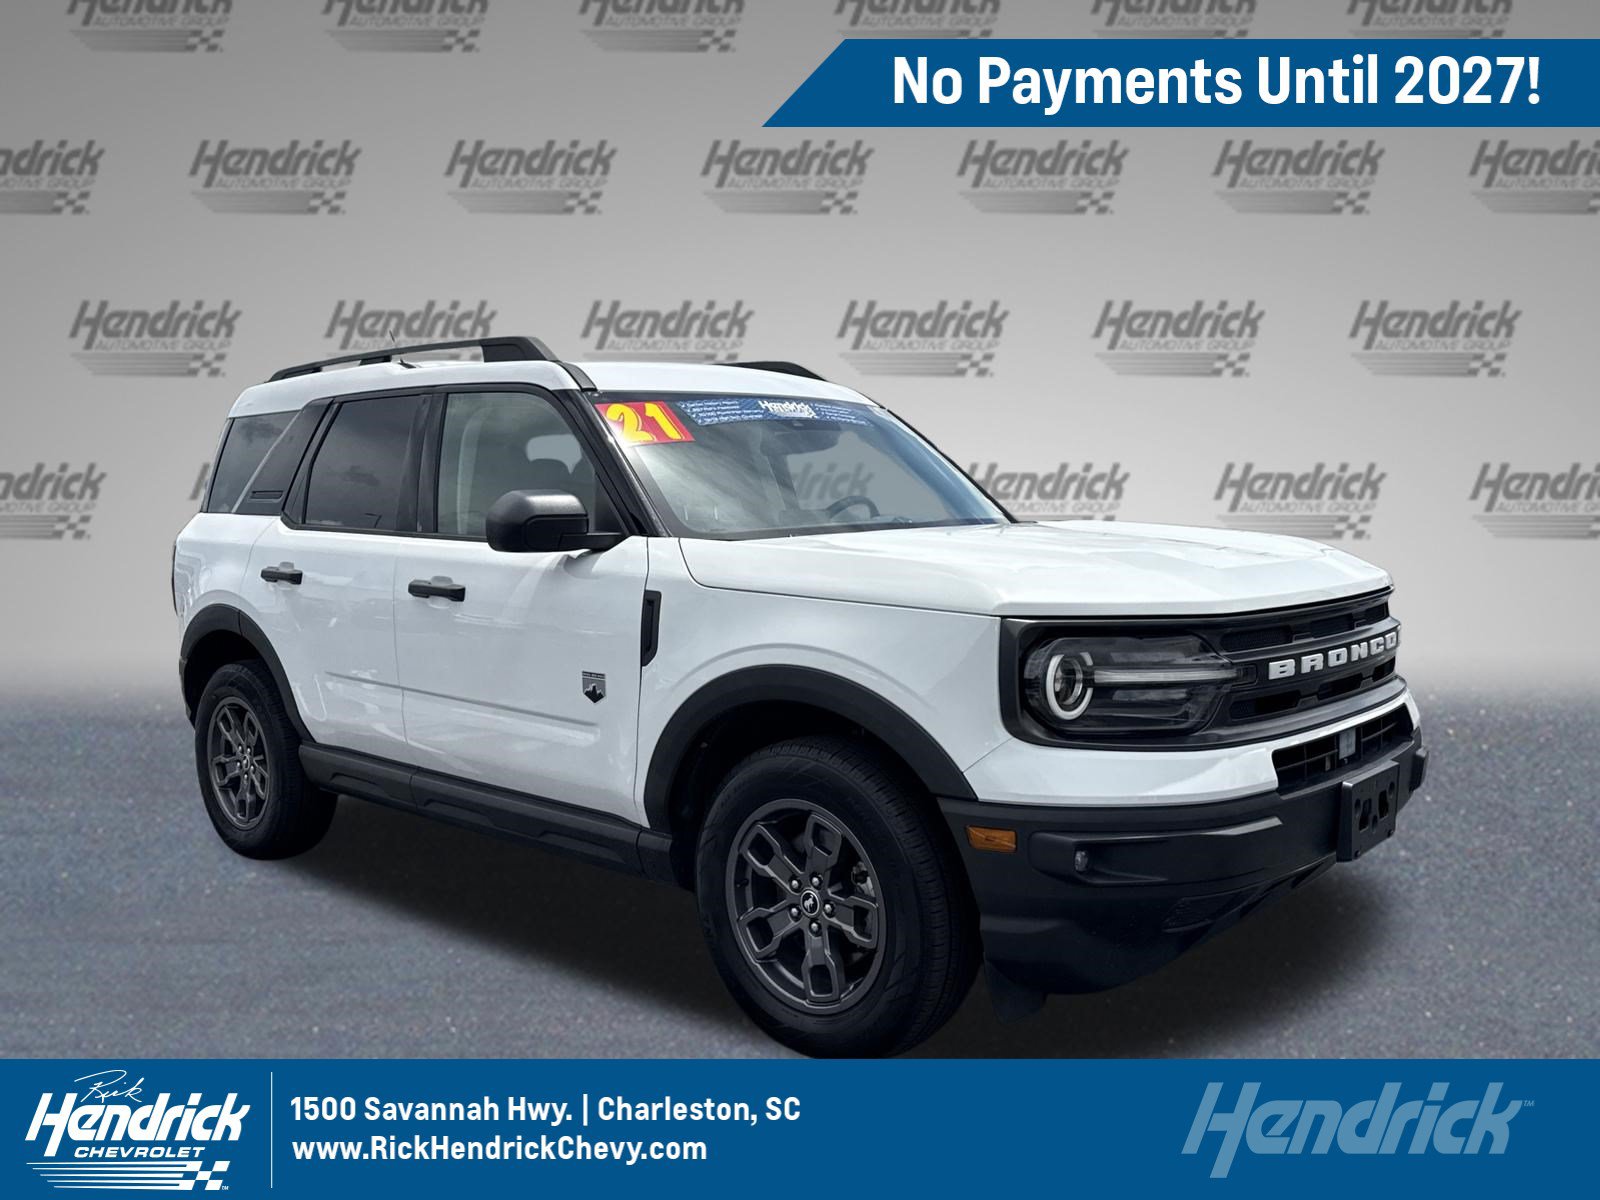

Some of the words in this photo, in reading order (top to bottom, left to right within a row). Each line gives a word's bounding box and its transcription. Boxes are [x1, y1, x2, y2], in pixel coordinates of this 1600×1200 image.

[0, 139, 106, 176] ndrick
[189, 139, 362, 188] Hendrick
[445, 139, 618, 188] Hendrick
[701, 139, 874, 188] Hendrick
[957, 139, 1130, 188] Hendrick
[1213, 139, 1386, 188] Hendrick
[1469, 139, 1600, 188] Hendri
[69, 300, 242, 350] Hendrick
[325, 300, 498, 350] Hendrick
[581, 300, 754, 350] Hendrick
[837, 300, 1010, 350] Hendrick
[1093, 300, 1266, 350] Hendrick
[1349, 300, 1522, 350] Hendrick
[606, 403, 684, 442] 21
[0, 462, 107, 500] ndrick
[1213, 462, 1387, 512] Hendrick
[1469, 462, 1600, 513] Hendri
[1268, 631, 1397, 680] BRONCO
